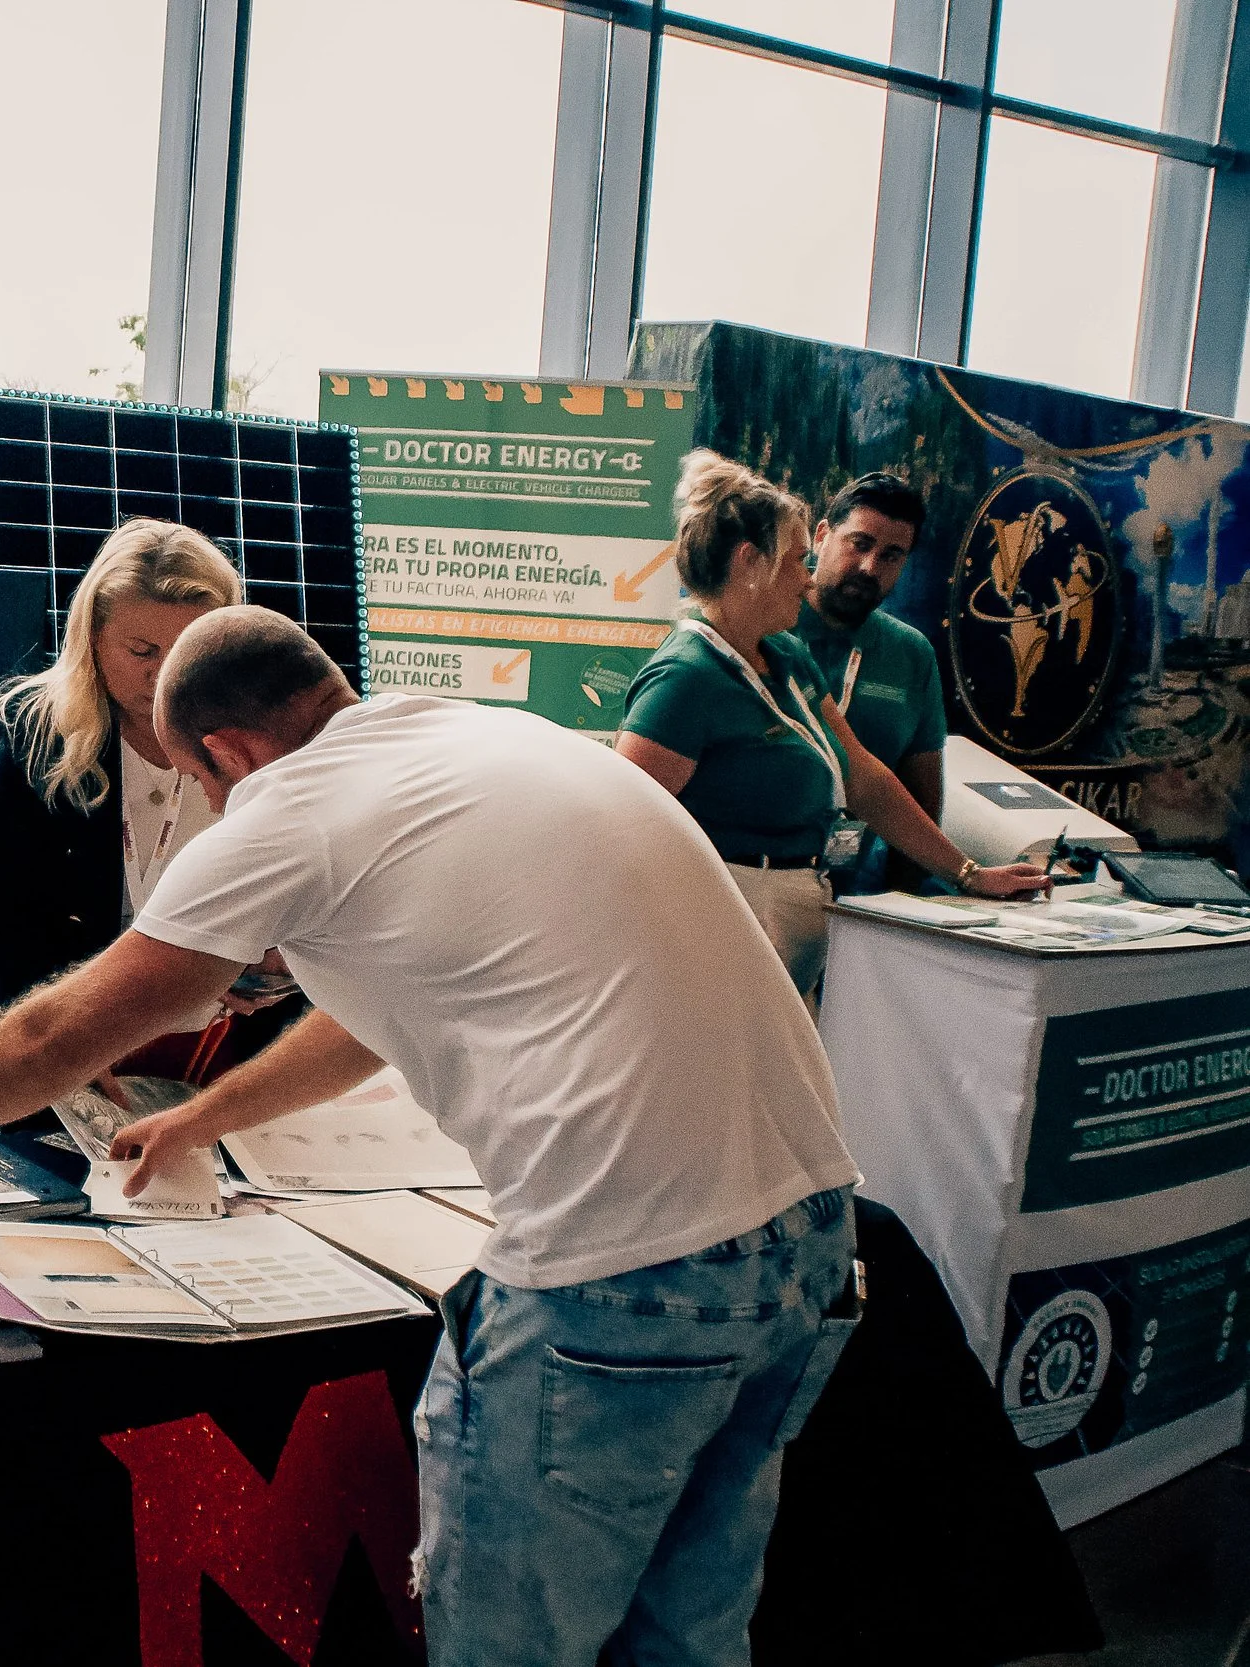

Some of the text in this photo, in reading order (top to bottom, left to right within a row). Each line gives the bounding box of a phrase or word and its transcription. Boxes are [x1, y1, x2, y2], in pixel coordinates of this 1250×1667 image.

[385, 439, 608, 471] DOCTOR ENERGY
[402, 475, 448, 488] PANELS
[451, 478, 461, 489] &
[466, 479, 520, 492] ELECTRIC
[524, 482, 571, 495] VEHICLE
[576, 484, 641, 499] CHARGERS
[364, 536, 564, 566] RA ES EL MOMENTO,
[364, 556, 608, 588] ERA TU PROPIA ENERGÍA.
[384, 580, 404, 594] TU
[407, 581, 479, 600] FACTURA,
[484, 586, 548, 601] AHORRA
[552, 590, 576, 605] YA!
[371, 613, 437, 630] ALISTAS
[442, 617, 465, 630] EN
[470, 619, 559, 637] EFICIENCIA
[370, 649, 463, 669] LACIONES
[369, 668, 463, 688] VOLTAICAS
[1103, 1058, 1190, 1104] DOCTOR
